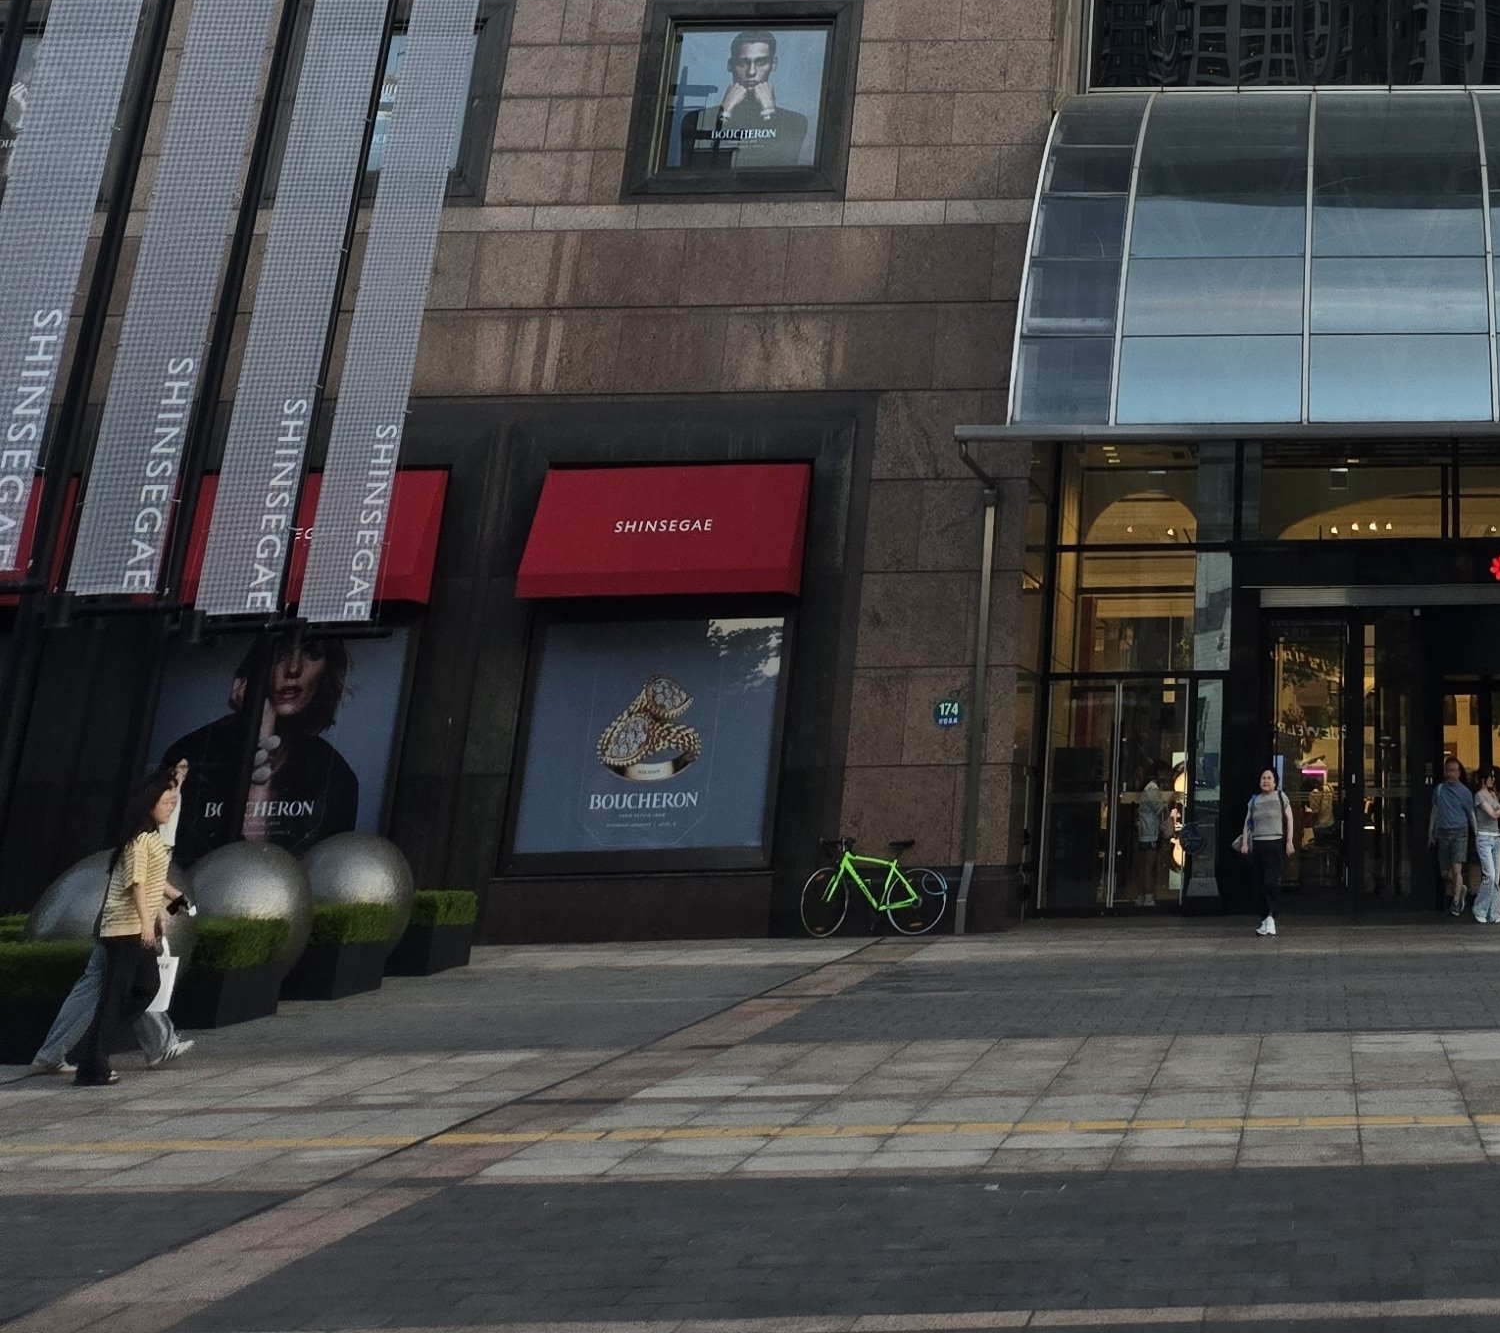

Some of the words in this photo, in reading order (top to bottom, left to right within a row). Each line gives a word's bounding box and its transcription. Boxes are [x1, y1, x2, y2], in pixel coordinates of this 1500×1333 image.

[711, 128, 777, 139] BOUCHERON
[122, 357, 194, 590] SHINSEGAE
[245, 399, 307, 610] SHINSEGAE
[343, 424, 398, 616] SHINSEGAE
[614, 518, 713, 532] SHINSEGAE
[939, 702, 958, 716] 174
[204, 800, 315, 818] BCHERON
[589, 791, 699, 810] BOUCHERON
